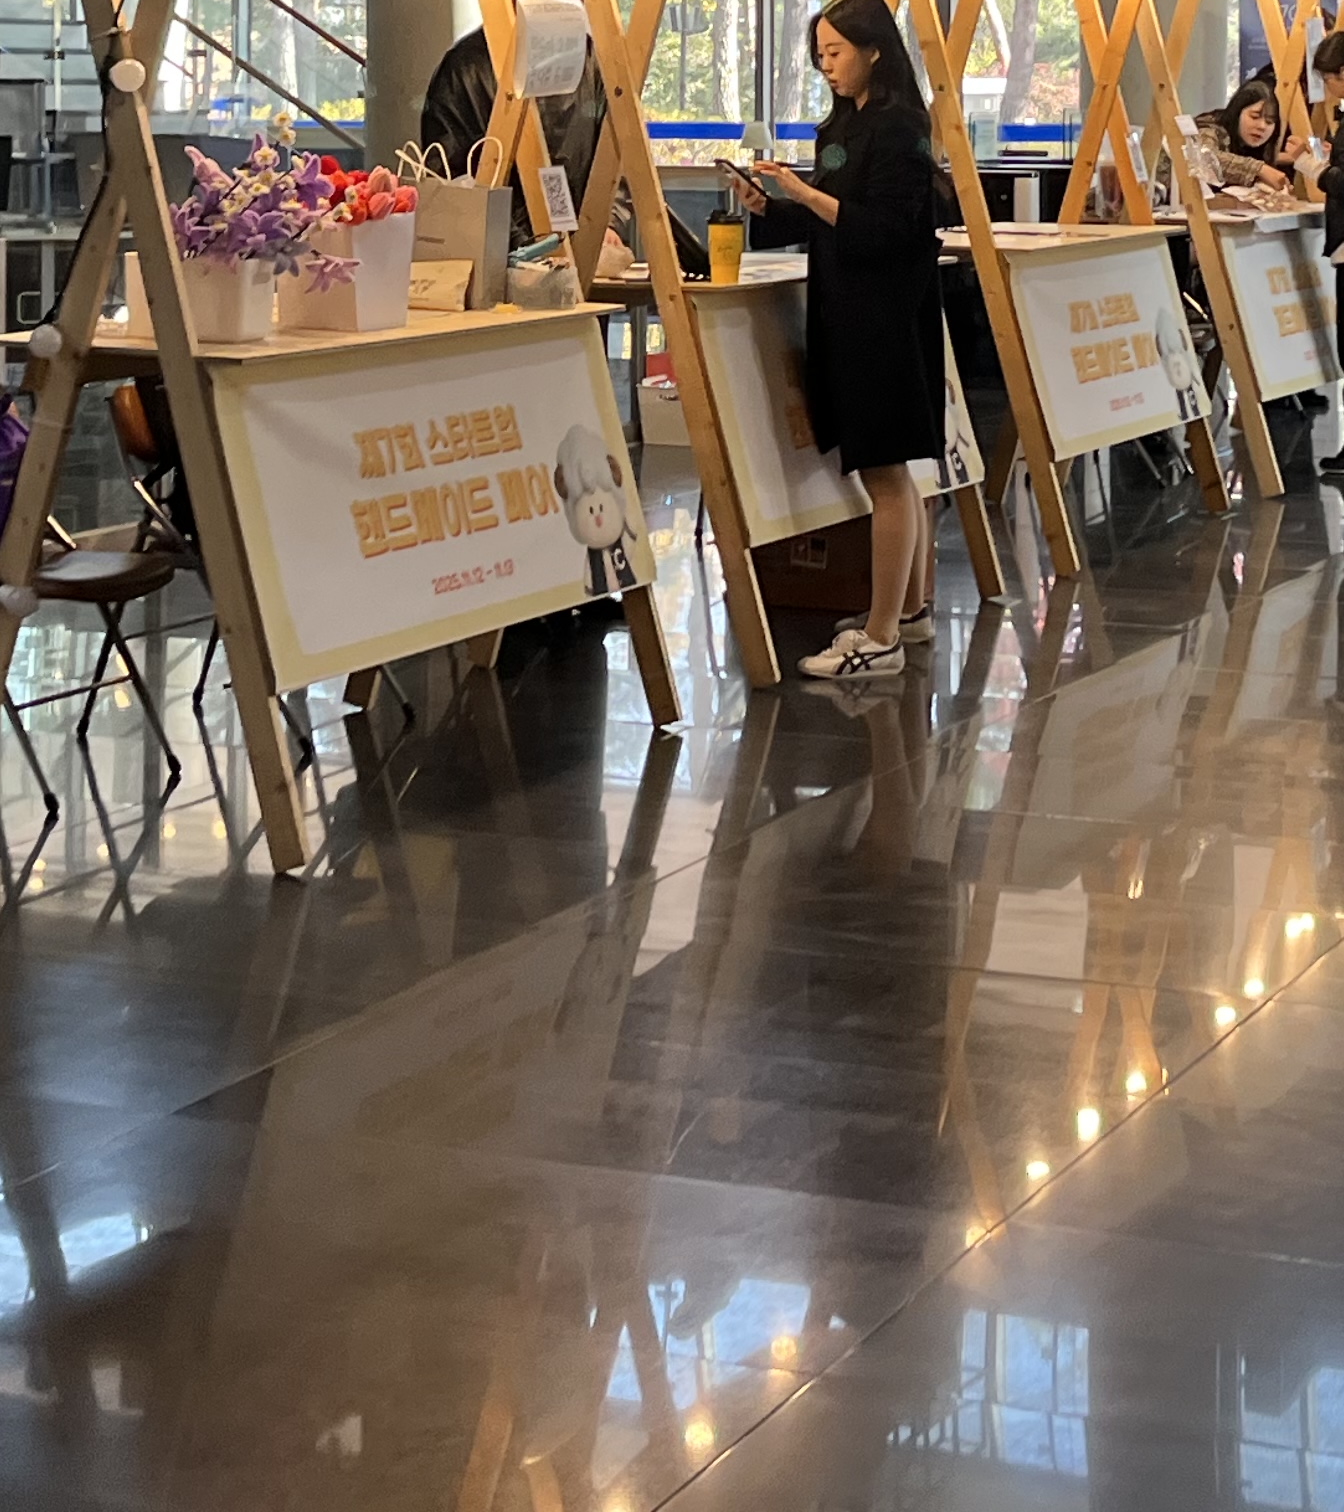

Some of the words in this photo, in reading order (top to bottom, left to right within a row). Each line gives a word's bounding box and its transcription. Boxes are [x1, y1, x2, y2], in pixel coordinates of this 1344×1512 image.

[353, 422, 425, 480] 제7회
[427, 404, 523, 466] 스타트업
[350, 476, 499, 559] 핸드메이드
[497, 462, 559, 524] 페어
